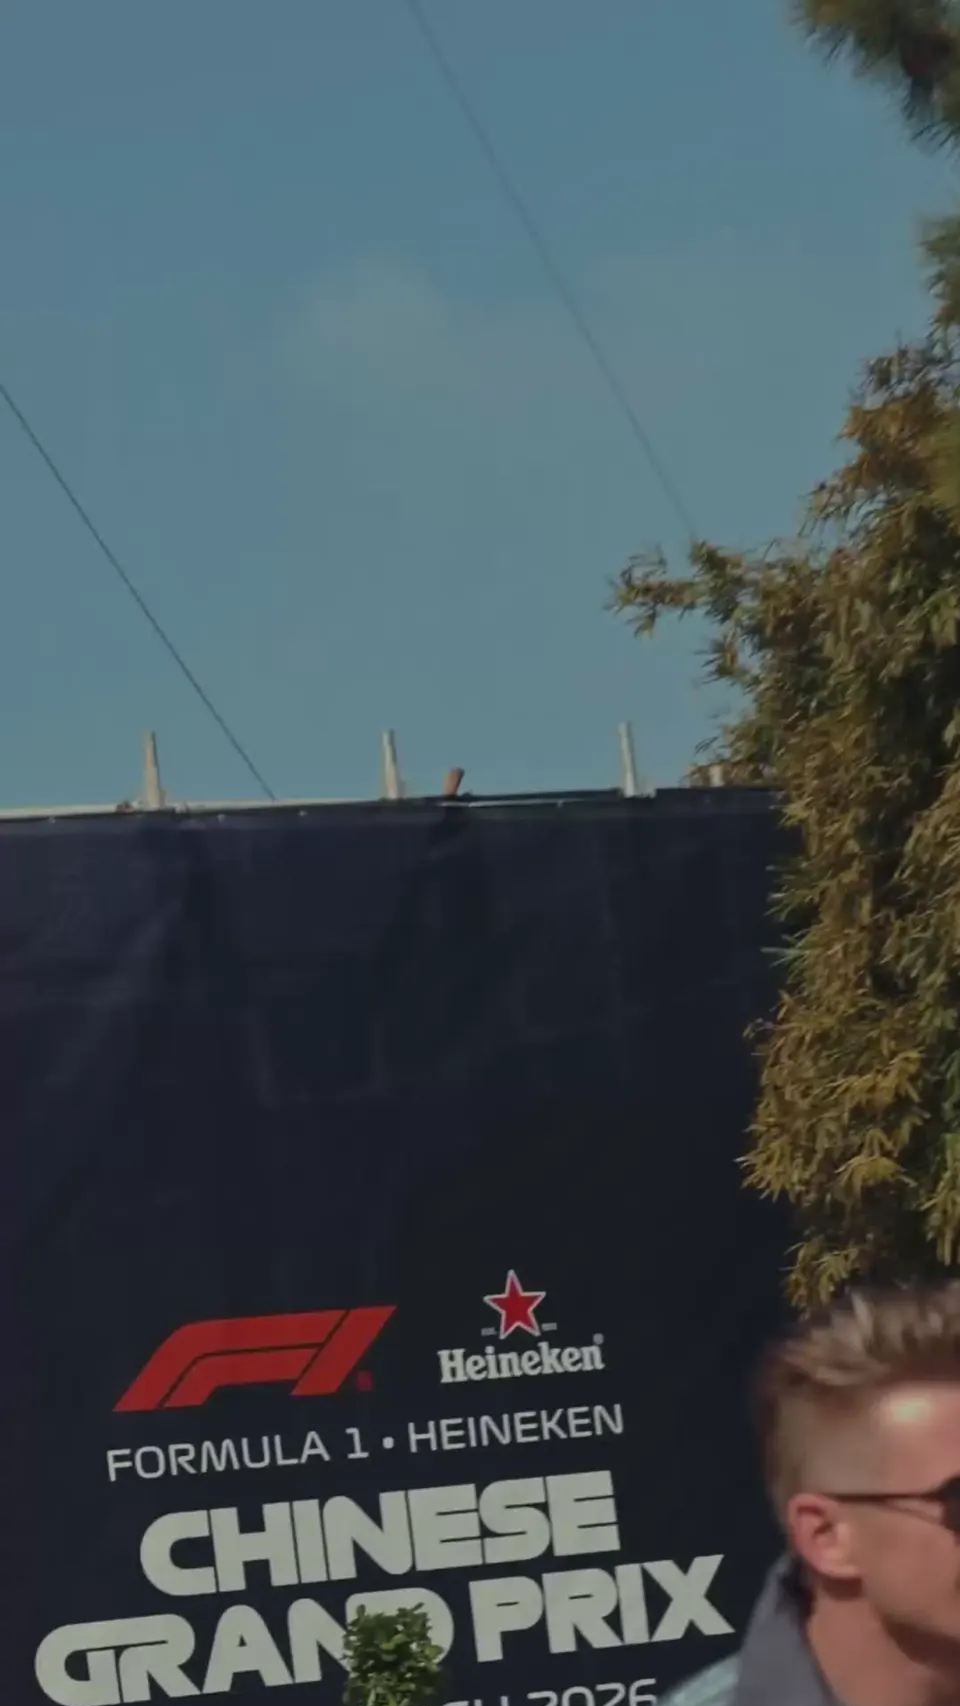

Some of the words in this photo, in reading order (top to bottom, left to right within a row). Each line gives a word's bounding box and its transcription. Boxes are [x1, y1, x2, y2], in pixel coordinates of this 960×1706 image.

[437, 1341, 605, 1383] Heineken
[106, 1430, 331, 1482] FORMULA
[345, 1427, 370, 1460] 1
[407, 1403, 625, 1453] HEINEKEN
[140, 1470, 621, 1596] CHINESE
[469, 1554, 735, 1663] PRIX
